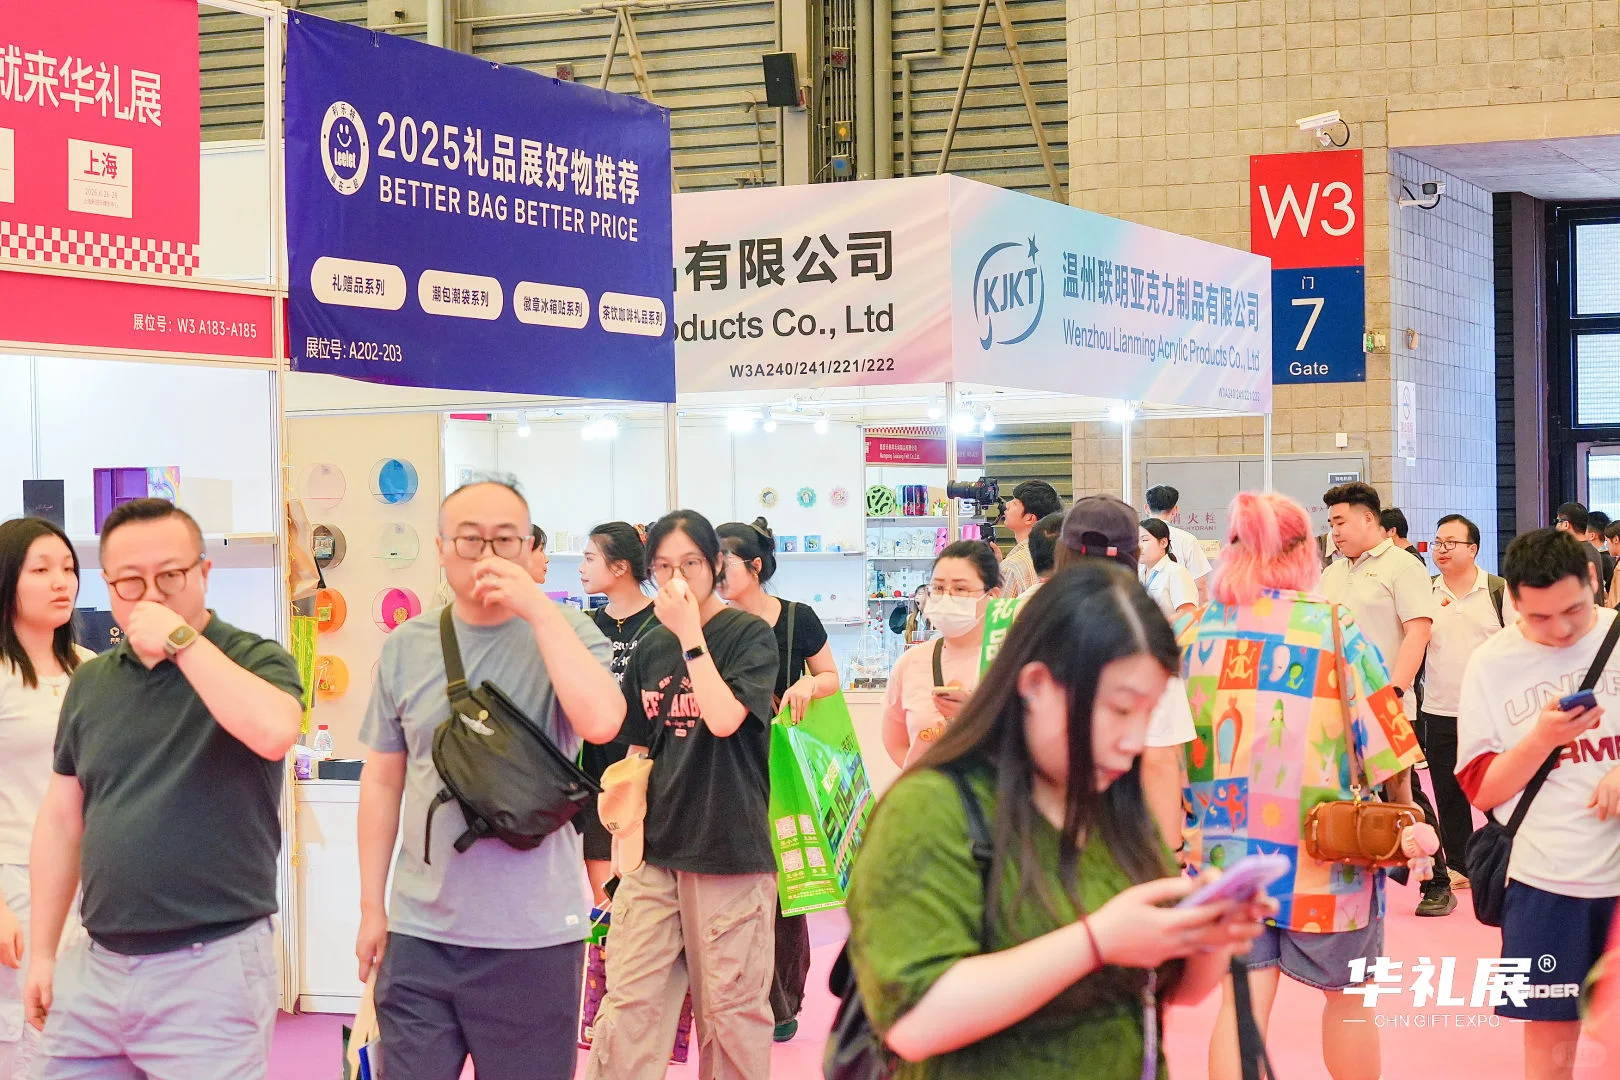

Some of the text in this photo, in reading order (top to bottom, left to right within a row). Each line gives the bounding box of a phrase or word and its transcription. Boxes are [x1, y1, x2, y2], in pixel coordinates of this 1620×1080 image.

[0, 44, 162, 127] 就来华礼展
[84, 149, 118, 179] 上海
[377, 111, 640, 205] 2025礼品展好物推荐
[379, 174, 638, 242] BETTER BAG BETTER PRICE
[1258, 181, 1356, 239] W3
[673, 230, 893, 293] 有限公司
[332, 273, 385, 296] 礼赠品系列
[432, 285, 489, 308] 潮包潮袋系列
[983, 267, 1038, 316] KJKT
[1062, 251, 1259, 332] 温州联明亚克力制品有限公司
[1301, 276, 1314, 290] 门
[523, 295, 583, 318] 徽章冰箱贴系列
[602, 305, 663, 327] 茶饮咖啡礼品系列
[674, 303, 894, 342] ducts Co., Ltd
[177, 317, 196, 334] W3
[199, 319, 257, 339] A183-A185
[1291, 297, 1325, 351] 7
[349, 341, 403, 363] A202-203
[1063, 317, 1112, 351] Wenzhou
[1113, 326, 1156, 363] Lianming
[1157, 334, 1188, 365] Acrylic
[1189, 339, 1228, 367] Products
[1247, 348, 1260, 372] Ltd
[729, 358, 895, 377] W3A240/241/221/222
[1289, 362, 1329, 375] Gate
